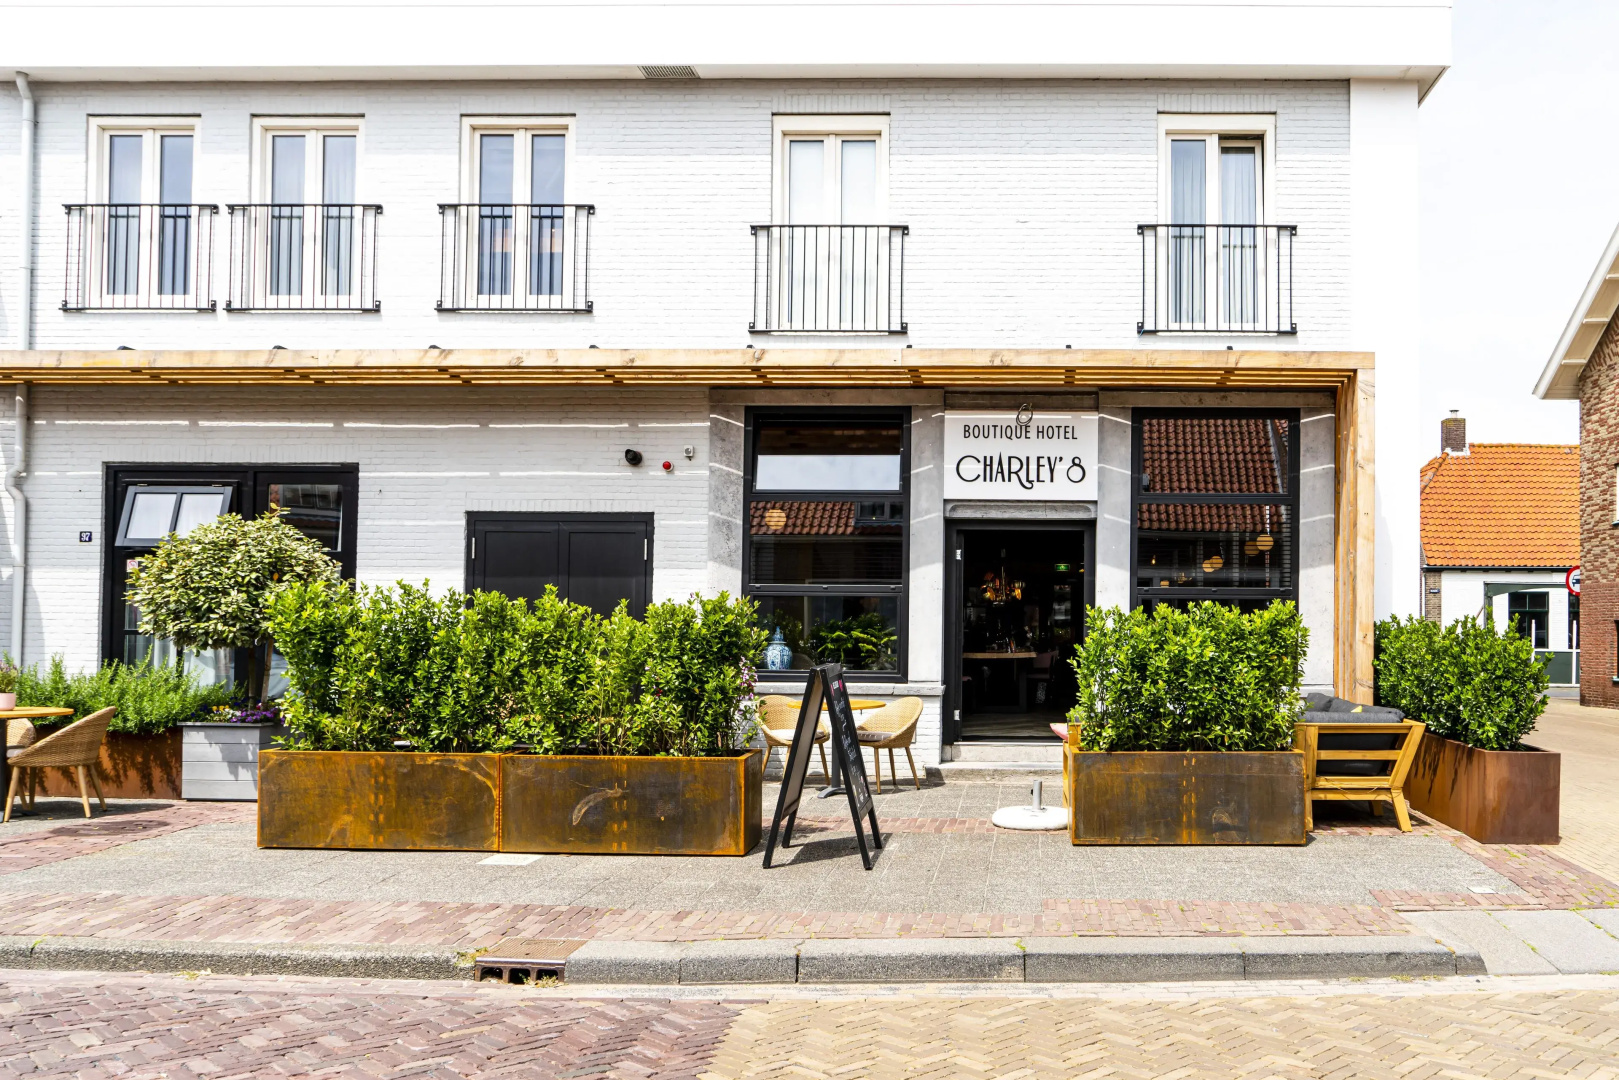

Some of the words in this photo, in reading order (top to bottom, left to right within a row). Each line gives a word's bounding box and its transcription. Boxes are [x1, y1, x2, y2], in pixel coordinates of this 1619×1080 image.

[963, 424, 1031, 440] BOUTIQUE
[1036, 425, 1078, 440] HOTEL
[81, 532, 91, 541] 97
